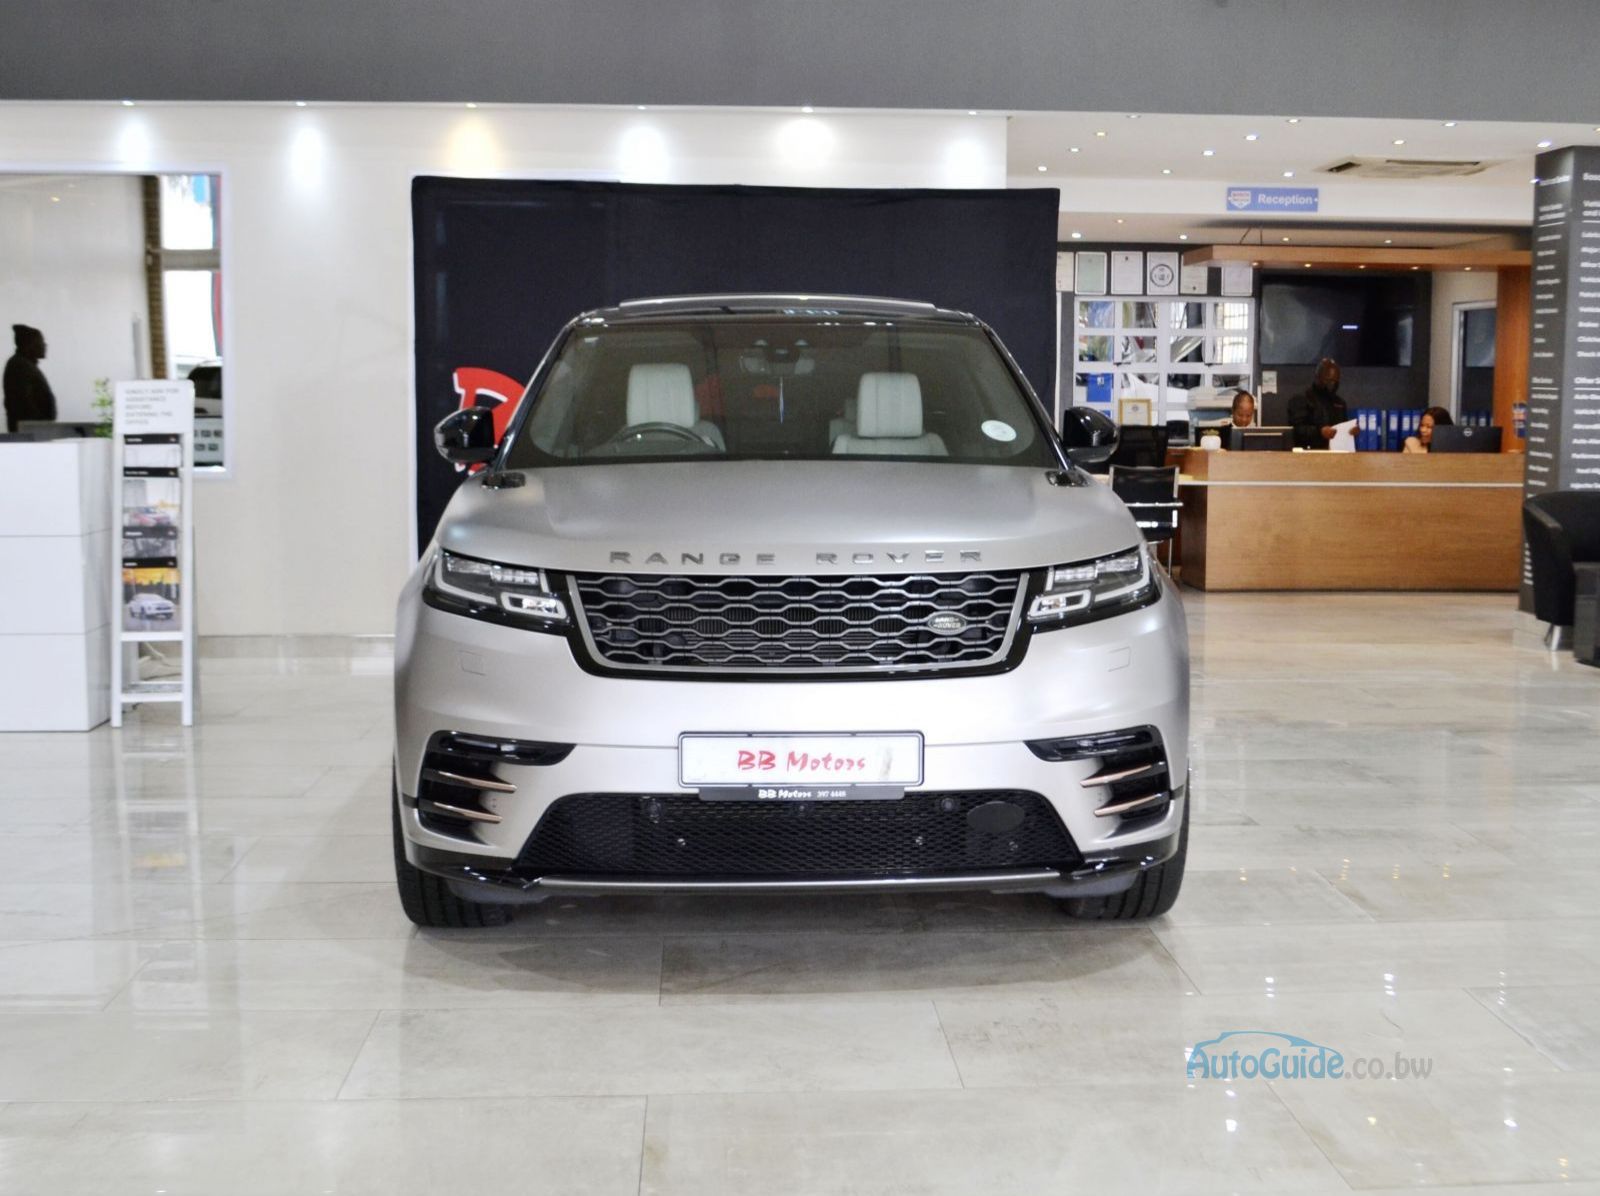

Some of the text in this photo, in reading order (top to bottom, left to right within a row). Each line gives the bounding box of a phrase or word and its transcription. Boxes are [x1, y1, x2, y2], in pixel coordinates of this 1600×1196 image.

[1257, 193, 1313, 206] Reception
[609, 550, 982, 566] RANGE ROVER
[737, 750, 866, 772] BB Motors
[758, 788, 777, 799] BB
[778, 788, 812, 799] Motors
